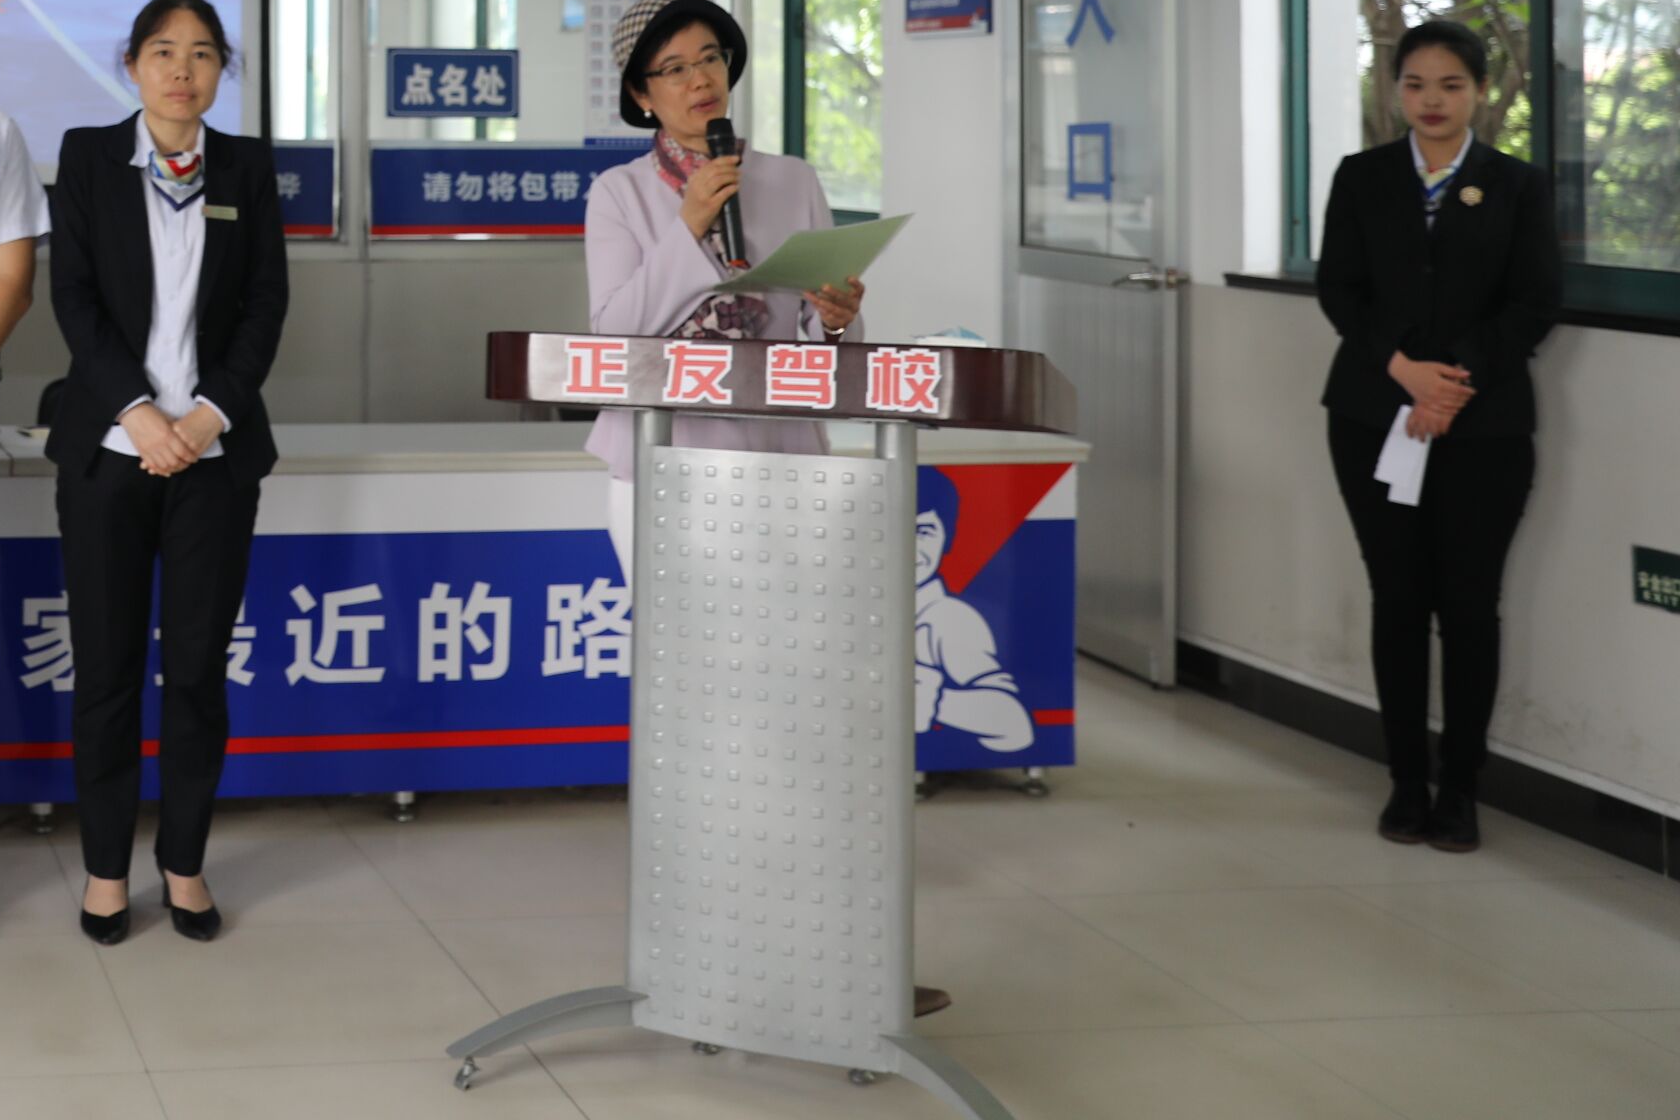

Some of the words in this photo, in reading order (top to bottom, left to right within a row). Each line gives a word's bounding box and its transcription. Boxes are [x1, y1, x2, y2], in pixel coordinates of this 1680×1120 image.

[401, 63, 507, 106] 点名处
[422, 171, 598, 202] 请勿将包带
[565, 339, 942, 413] 正友驾校
